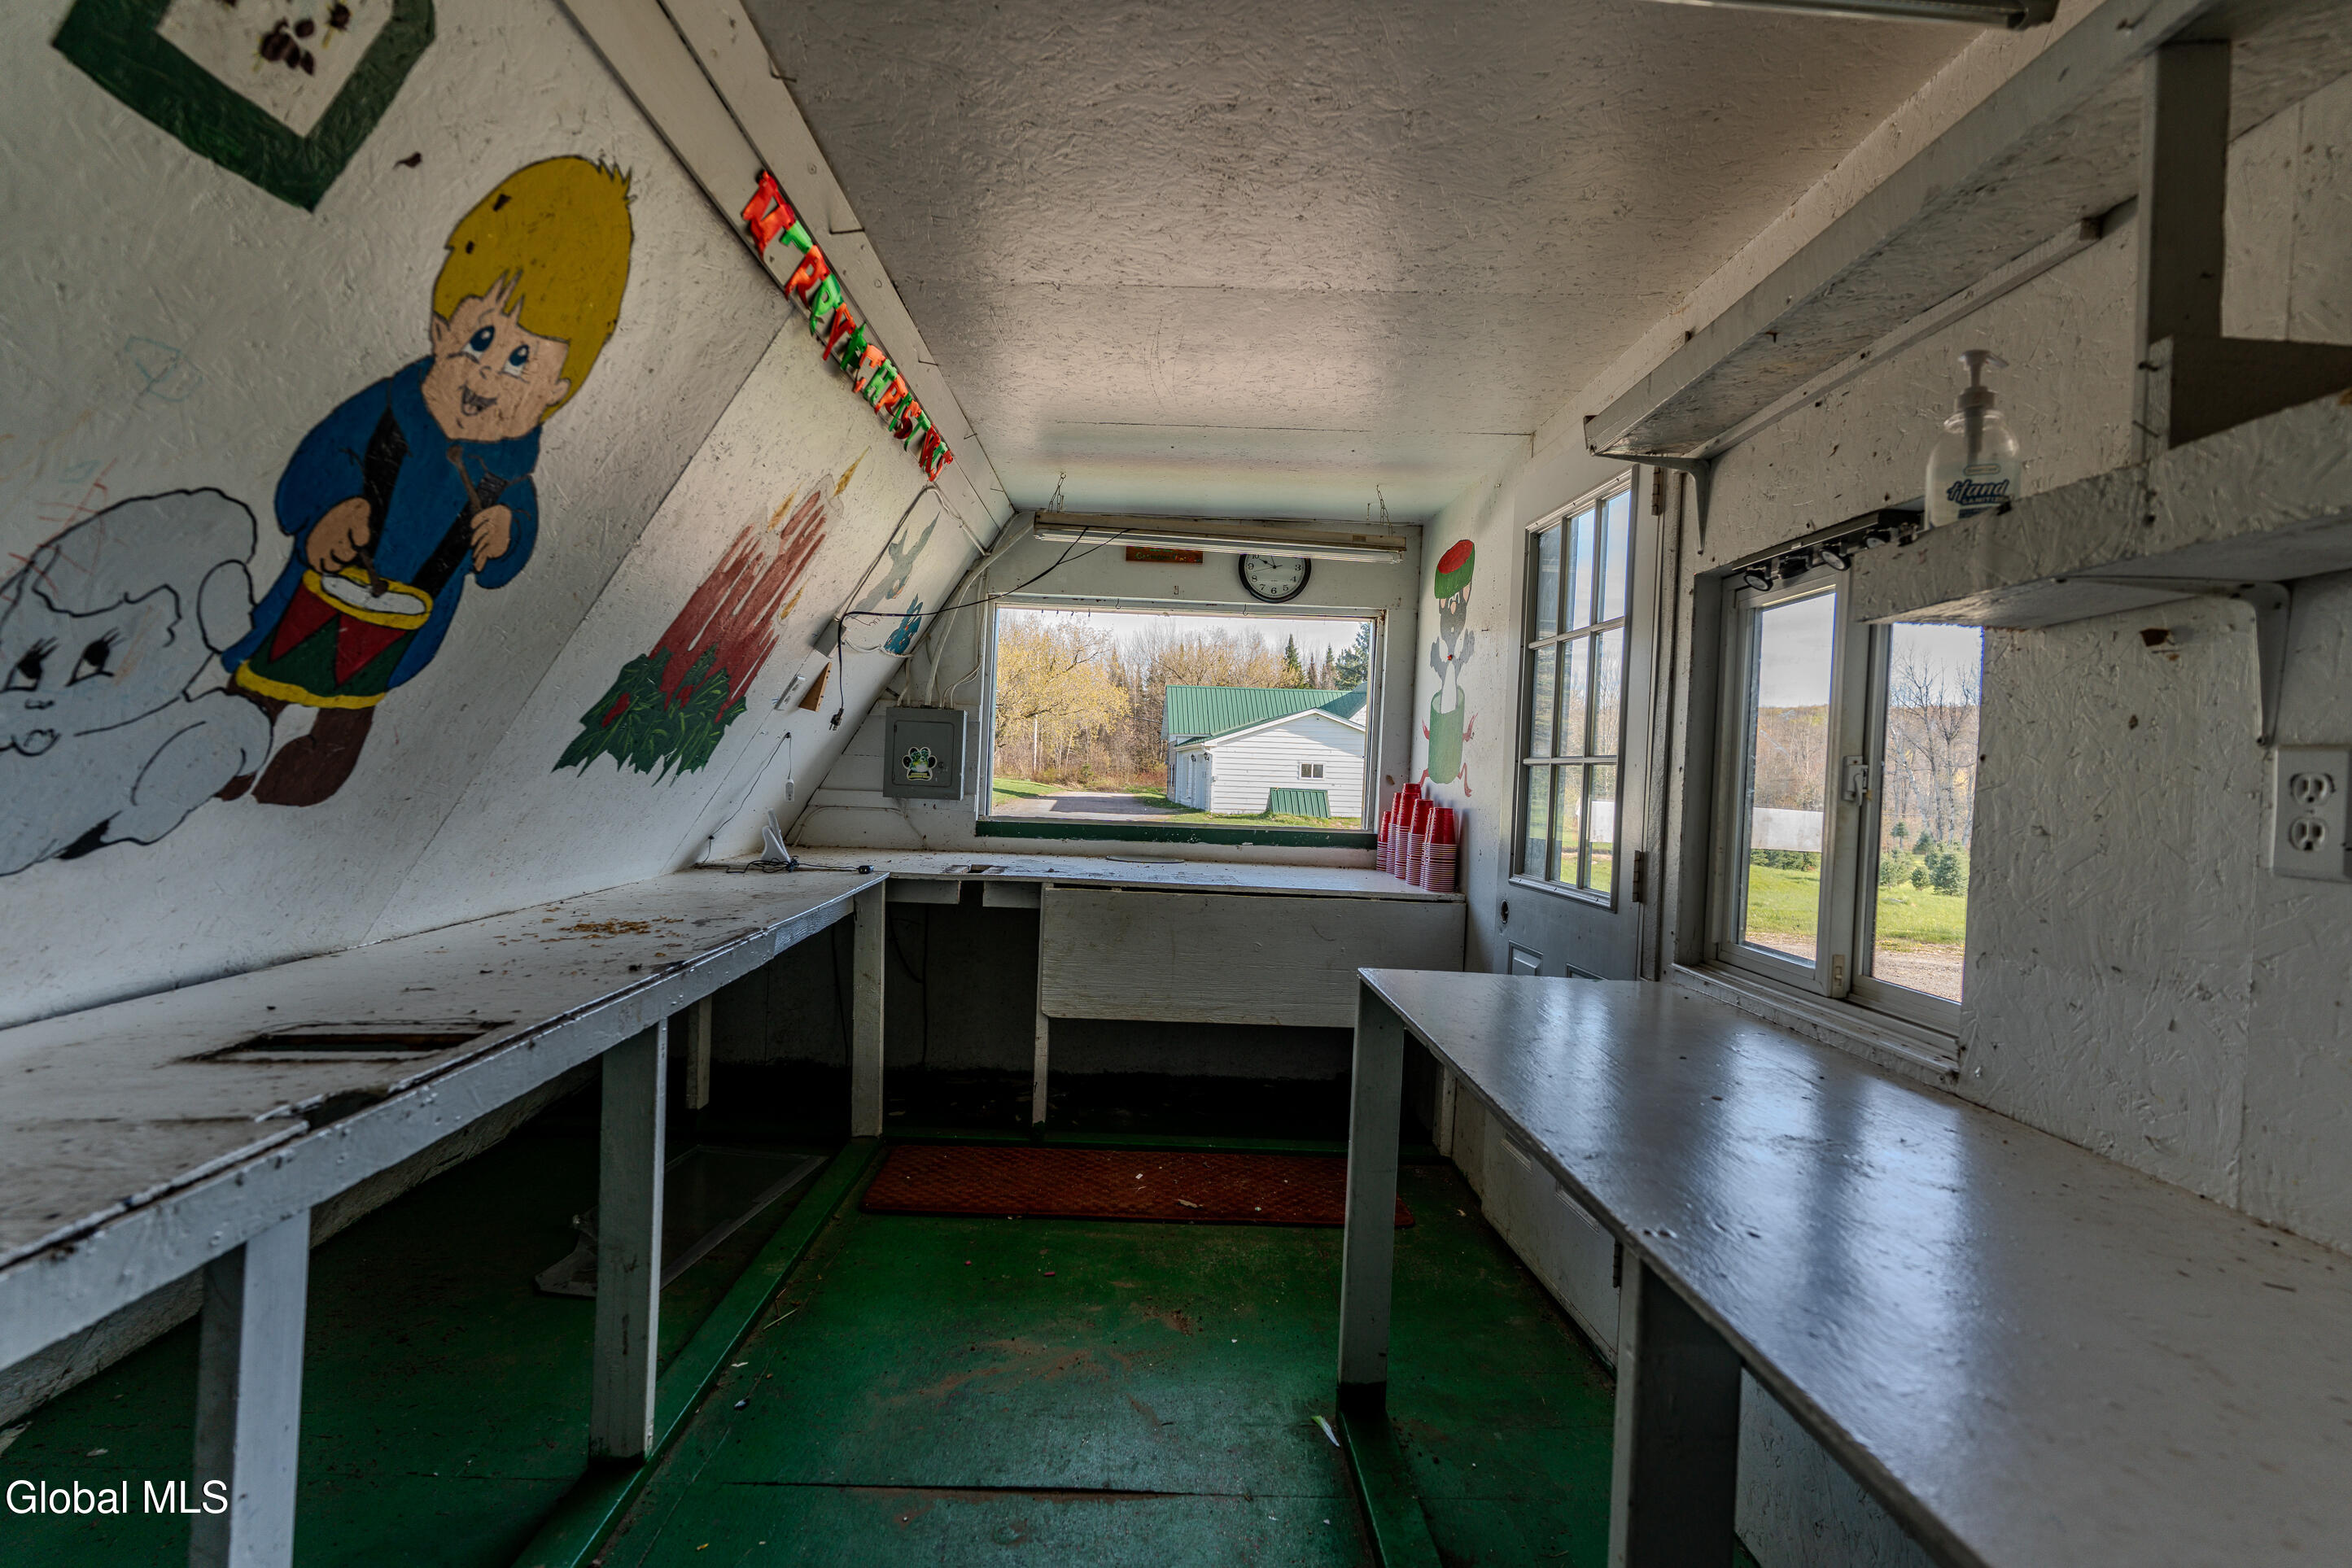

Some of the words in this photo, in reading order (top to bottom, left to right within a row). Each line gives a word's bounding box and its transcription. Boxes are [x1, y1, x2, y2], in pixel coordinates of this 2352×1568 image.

[741, 170, 857, 361] MRRY
[1947, 478, 2010, 504] Hand
[1248, 562, 1255, 570] 9
[1295, 564, 1302, 572] 3
[1251, 574, 1258, 583] 8
[1270, 587, 1277, 595] 6
